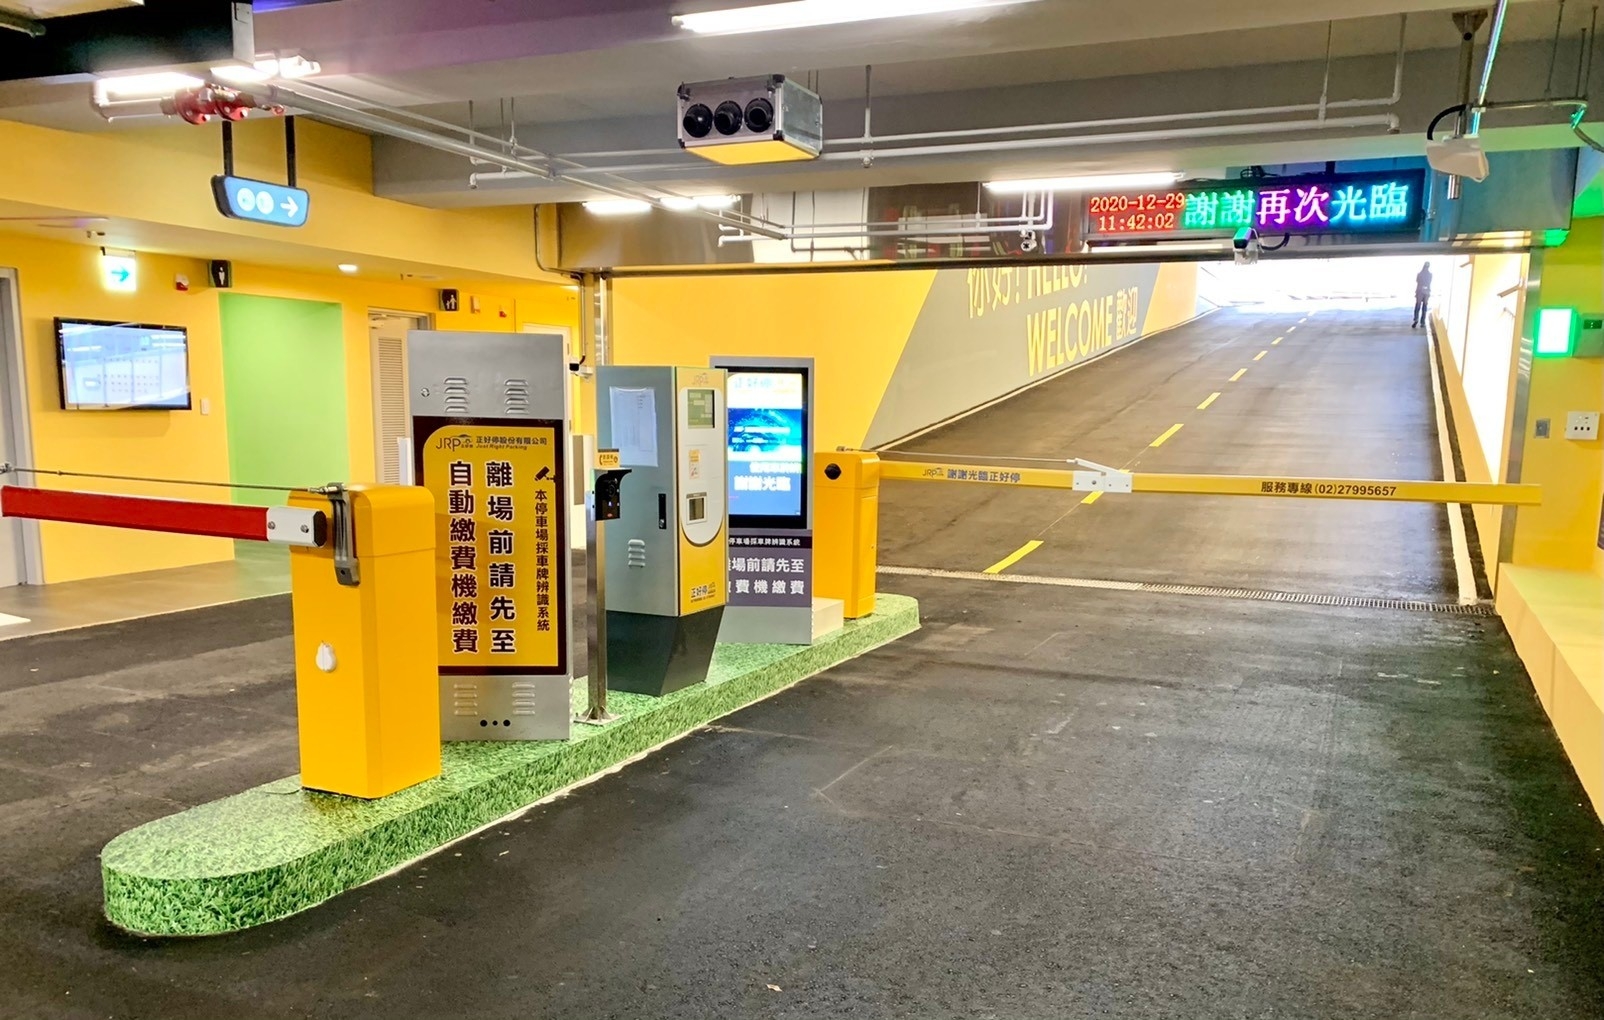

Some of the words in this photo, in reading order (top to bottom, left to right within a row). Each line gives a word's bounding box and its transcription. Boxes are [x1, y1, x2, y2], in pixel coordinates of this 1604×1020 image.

[1090, 192, 1185, 213] 2020-12-29
[1185, 182, 1409, 226] 謝謝再次光臨
[1099, 213, 1174, 231] 11:42:02
[1026, 294, 1113, 377] WELCOME
[1116, 286, 1140, 341] 歡迎
[436, 438, 461, 452] JRP
[476, 435, 548, 445] 正好停股份有限公司
[947, 468, 1021, 483] 謝謝光臨正好停
[1261, 481, 1313, 494] 服務專線
[1314, 484, 1397, 496] (02)27995657
[448, 460, 478, 654] 自動繳費機繳費
[486, 460, 516, 654] 離場前請先至
[535, 489, 550, 632] 本停車場採車牌辨識系統
[728, 557, 805, 573] 場前請先至
[728, 579, 805, 595] 費機繳費
